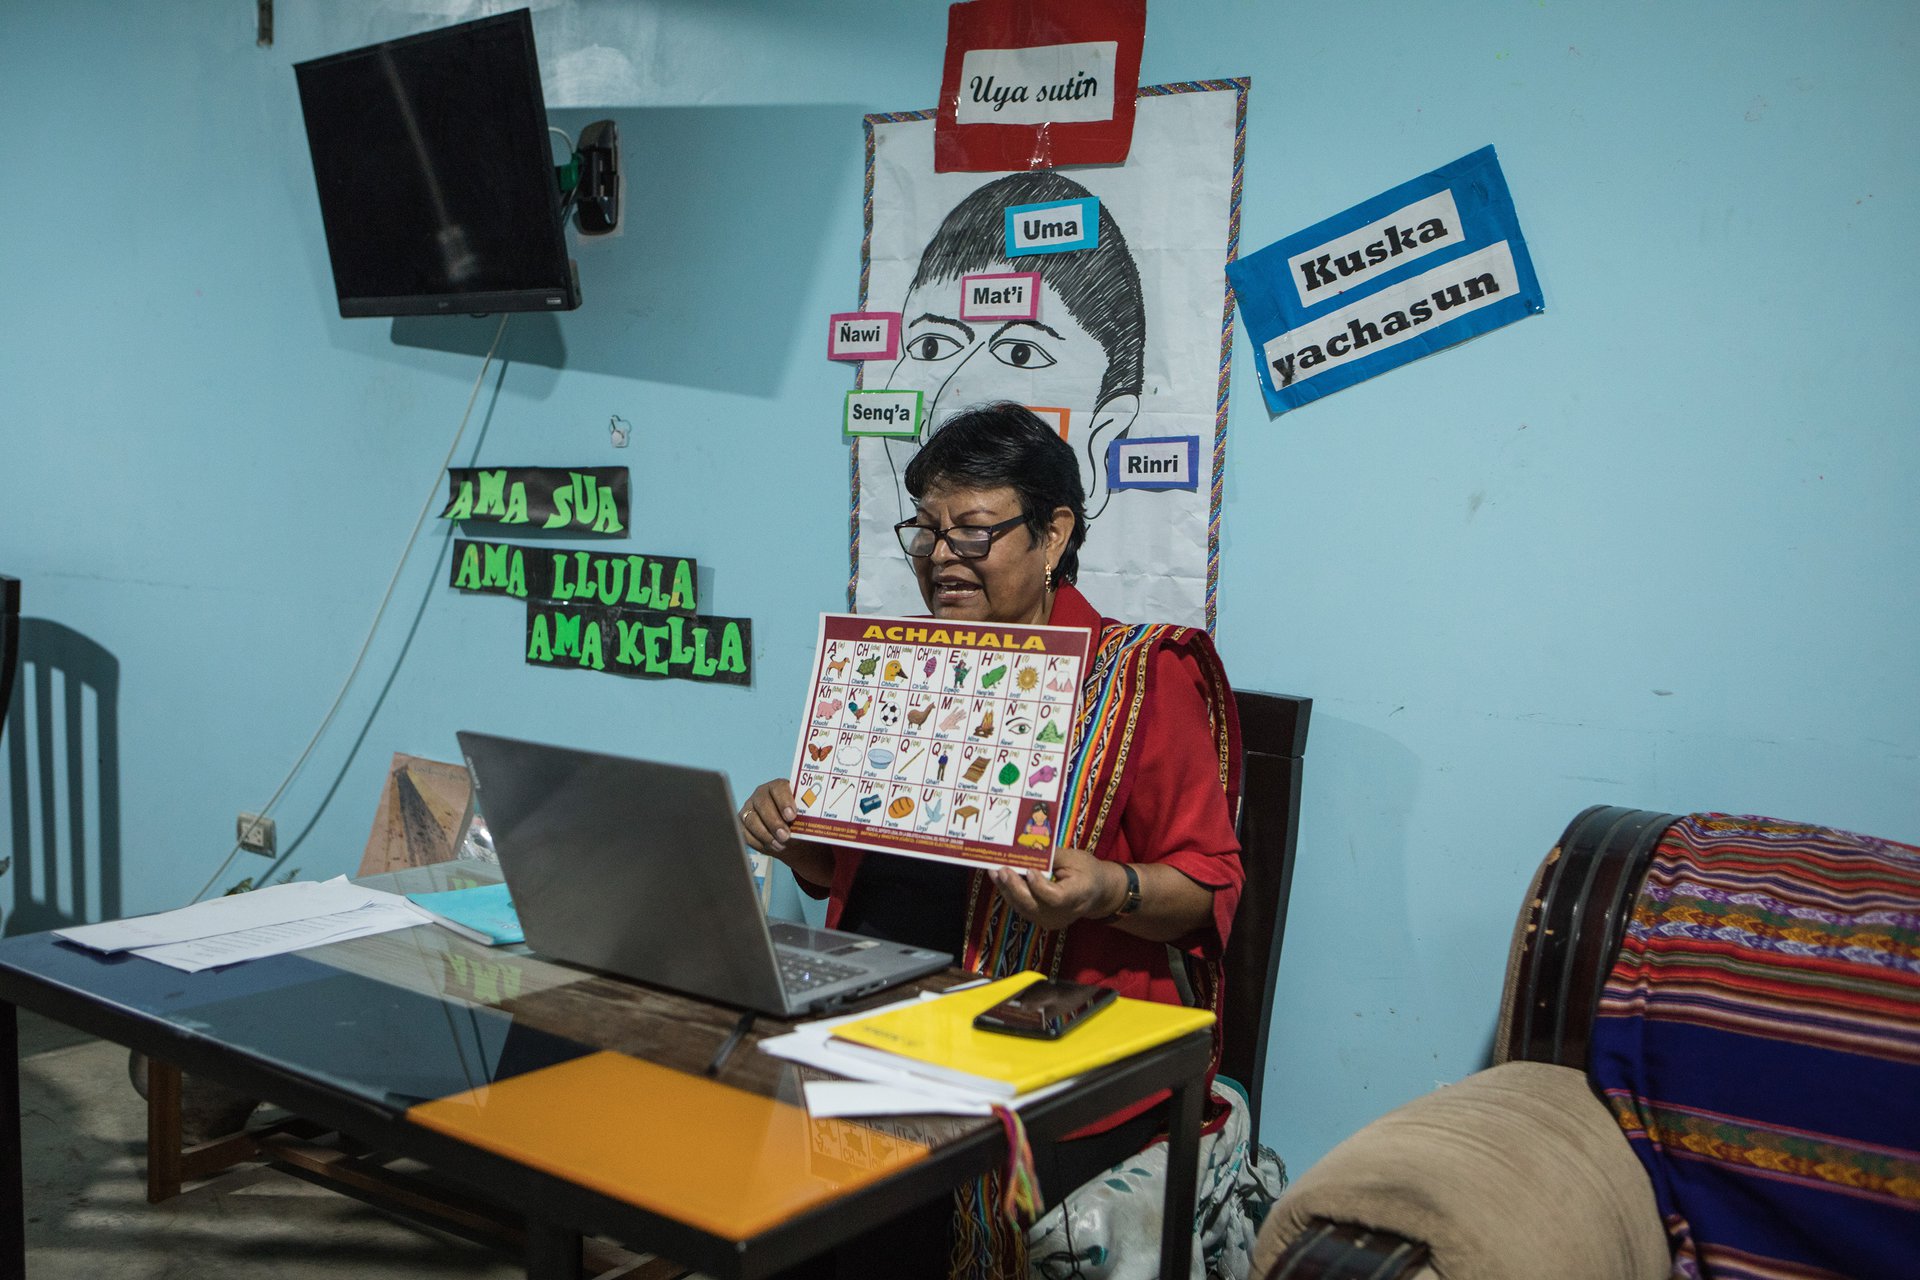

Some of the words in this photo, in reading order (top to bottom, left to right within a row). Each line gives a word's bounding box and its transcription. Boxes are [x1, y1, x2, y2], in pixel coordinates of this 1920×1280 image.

[970, 76, 1029, 112] Uya
[1036, 71, 1098, 102] sutin
[1022, 219, 1078, 240] Uma
[1300, 216, 1448, 292] Kuska
[972, 286, 1023, 305] Mat'i
[840, 323, 881, 342] Ñawi
[1272, 271, 1500, 388] yachasun
[852, 403, 911, 425] Senq'a
[1128, 454, 1178, 474] Rinri
[443, 470, 530, 524] AMA
[542, 471, 624, 534] SUA
[454, 543, 528, 598] AMA
[552, 551, 696, 611] LLULLA
[527, 611, 606, 671] AMA
[616, 616, 748, 677] KELLA
[862, 624, 1046, 651] ACHAHALA
[827, 641, 837, 654] A
[857, 643, 870, 656] CH
[887, 645, 902, 659] CHH
[949, 650, 960, 663] E
[981, 653, 993, 666] H
[1015, 655, 1021, 668] I
[1048, 657, 1059, 671] K
[819, 685, 831, 698] Kh
[878, 690, 886, 703] L
[909, 693, 920, 707] LL
[941, 696, 953, 709] M
[973, 700, 984, 712] N
[1007, 700, 1018, 715] Ñ
[1040, 705, 1051, 718] O
[810, 729, 818, 741] P
[839, 732, 853, 745] PH
[869, 735, 880, 748] P'
[901, 739, 910, 753] Q
[932, 742, 941, 756] Q
[964, 746, 977, 760] Q'
[997, 749, 1008, 763] R
[1031, 753, 1041, 767] S
[801, 773, 813, 786] Sh
[831, 777, 841, 789] T
[860, 780, 874, 794] TH
[892, 784, 903, 797] T'
[923, 788, 934, 802] U
[954, 792, 967, 806] W
[989, 796, 998, 810] Y
